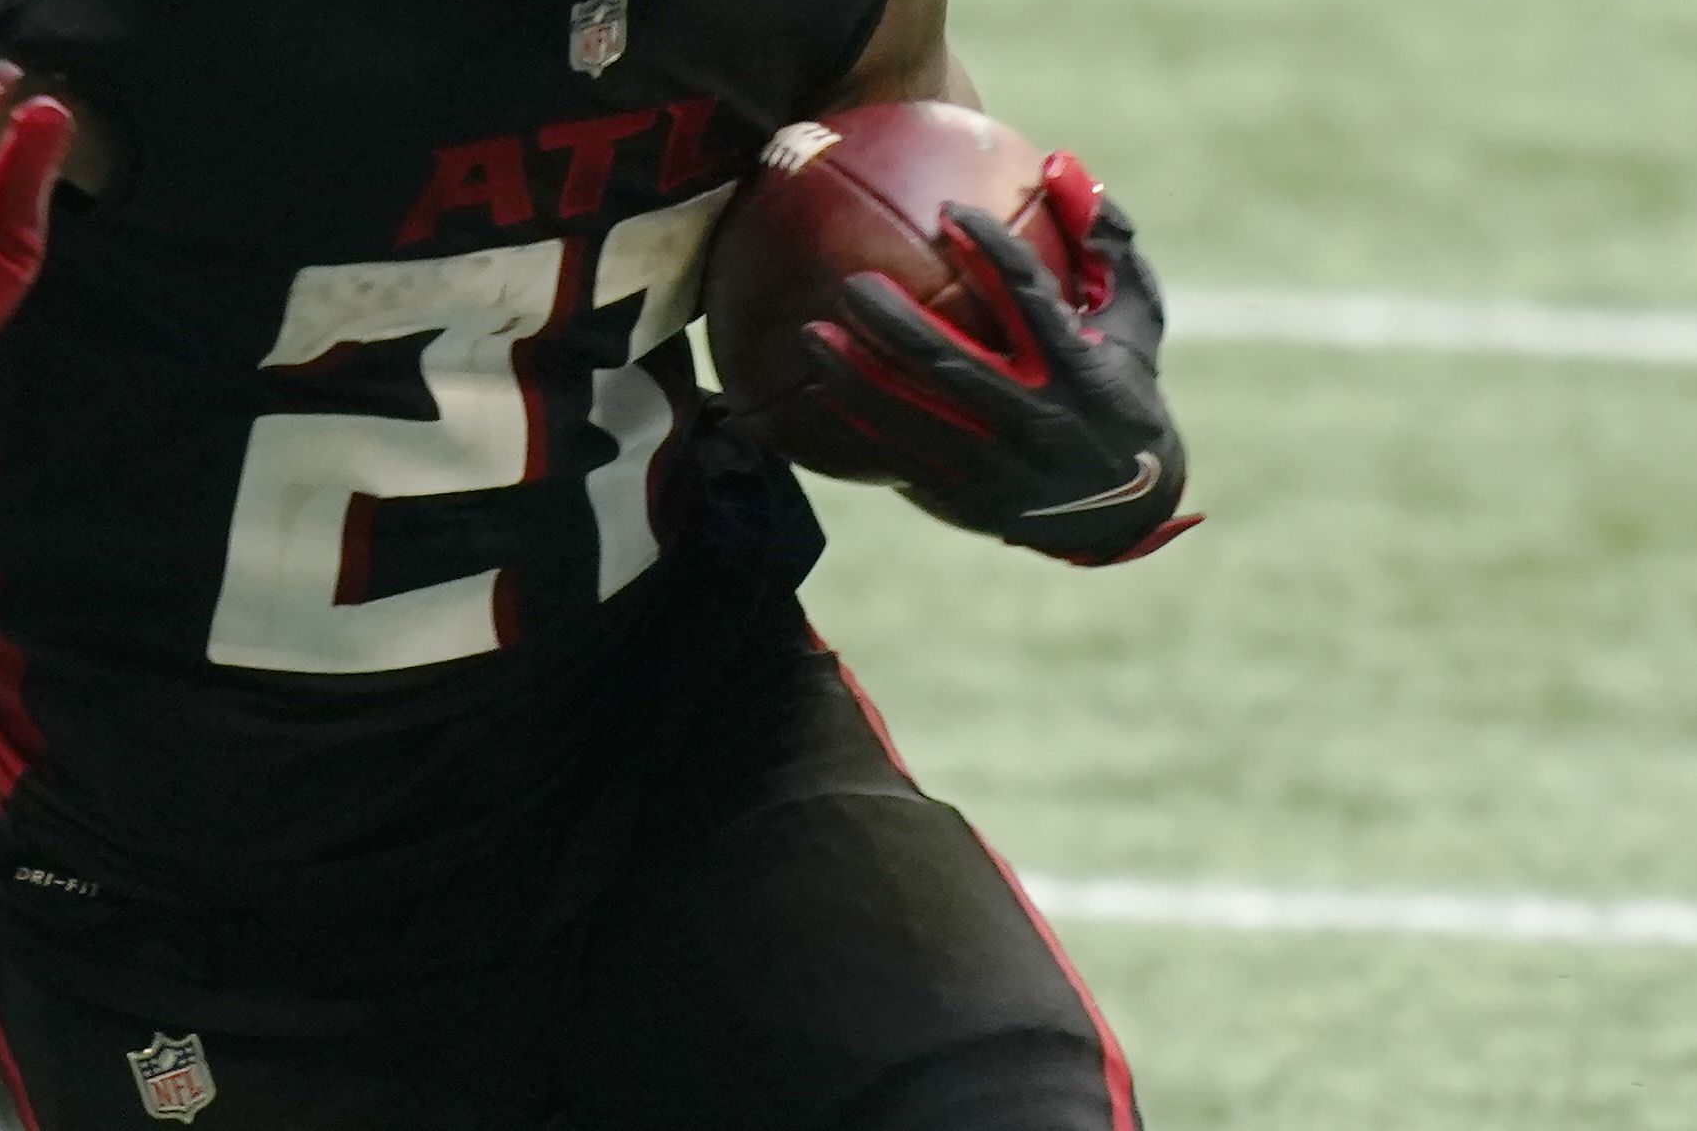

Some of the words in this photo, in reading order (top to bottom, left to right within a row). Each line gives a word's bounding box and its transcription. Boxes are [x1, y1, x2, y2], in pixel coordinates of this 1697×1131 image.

[392, 94, 727, 250] ATL
[207, 178, 739, 676] 21
[151, 1068, 204, 1108] NFL
